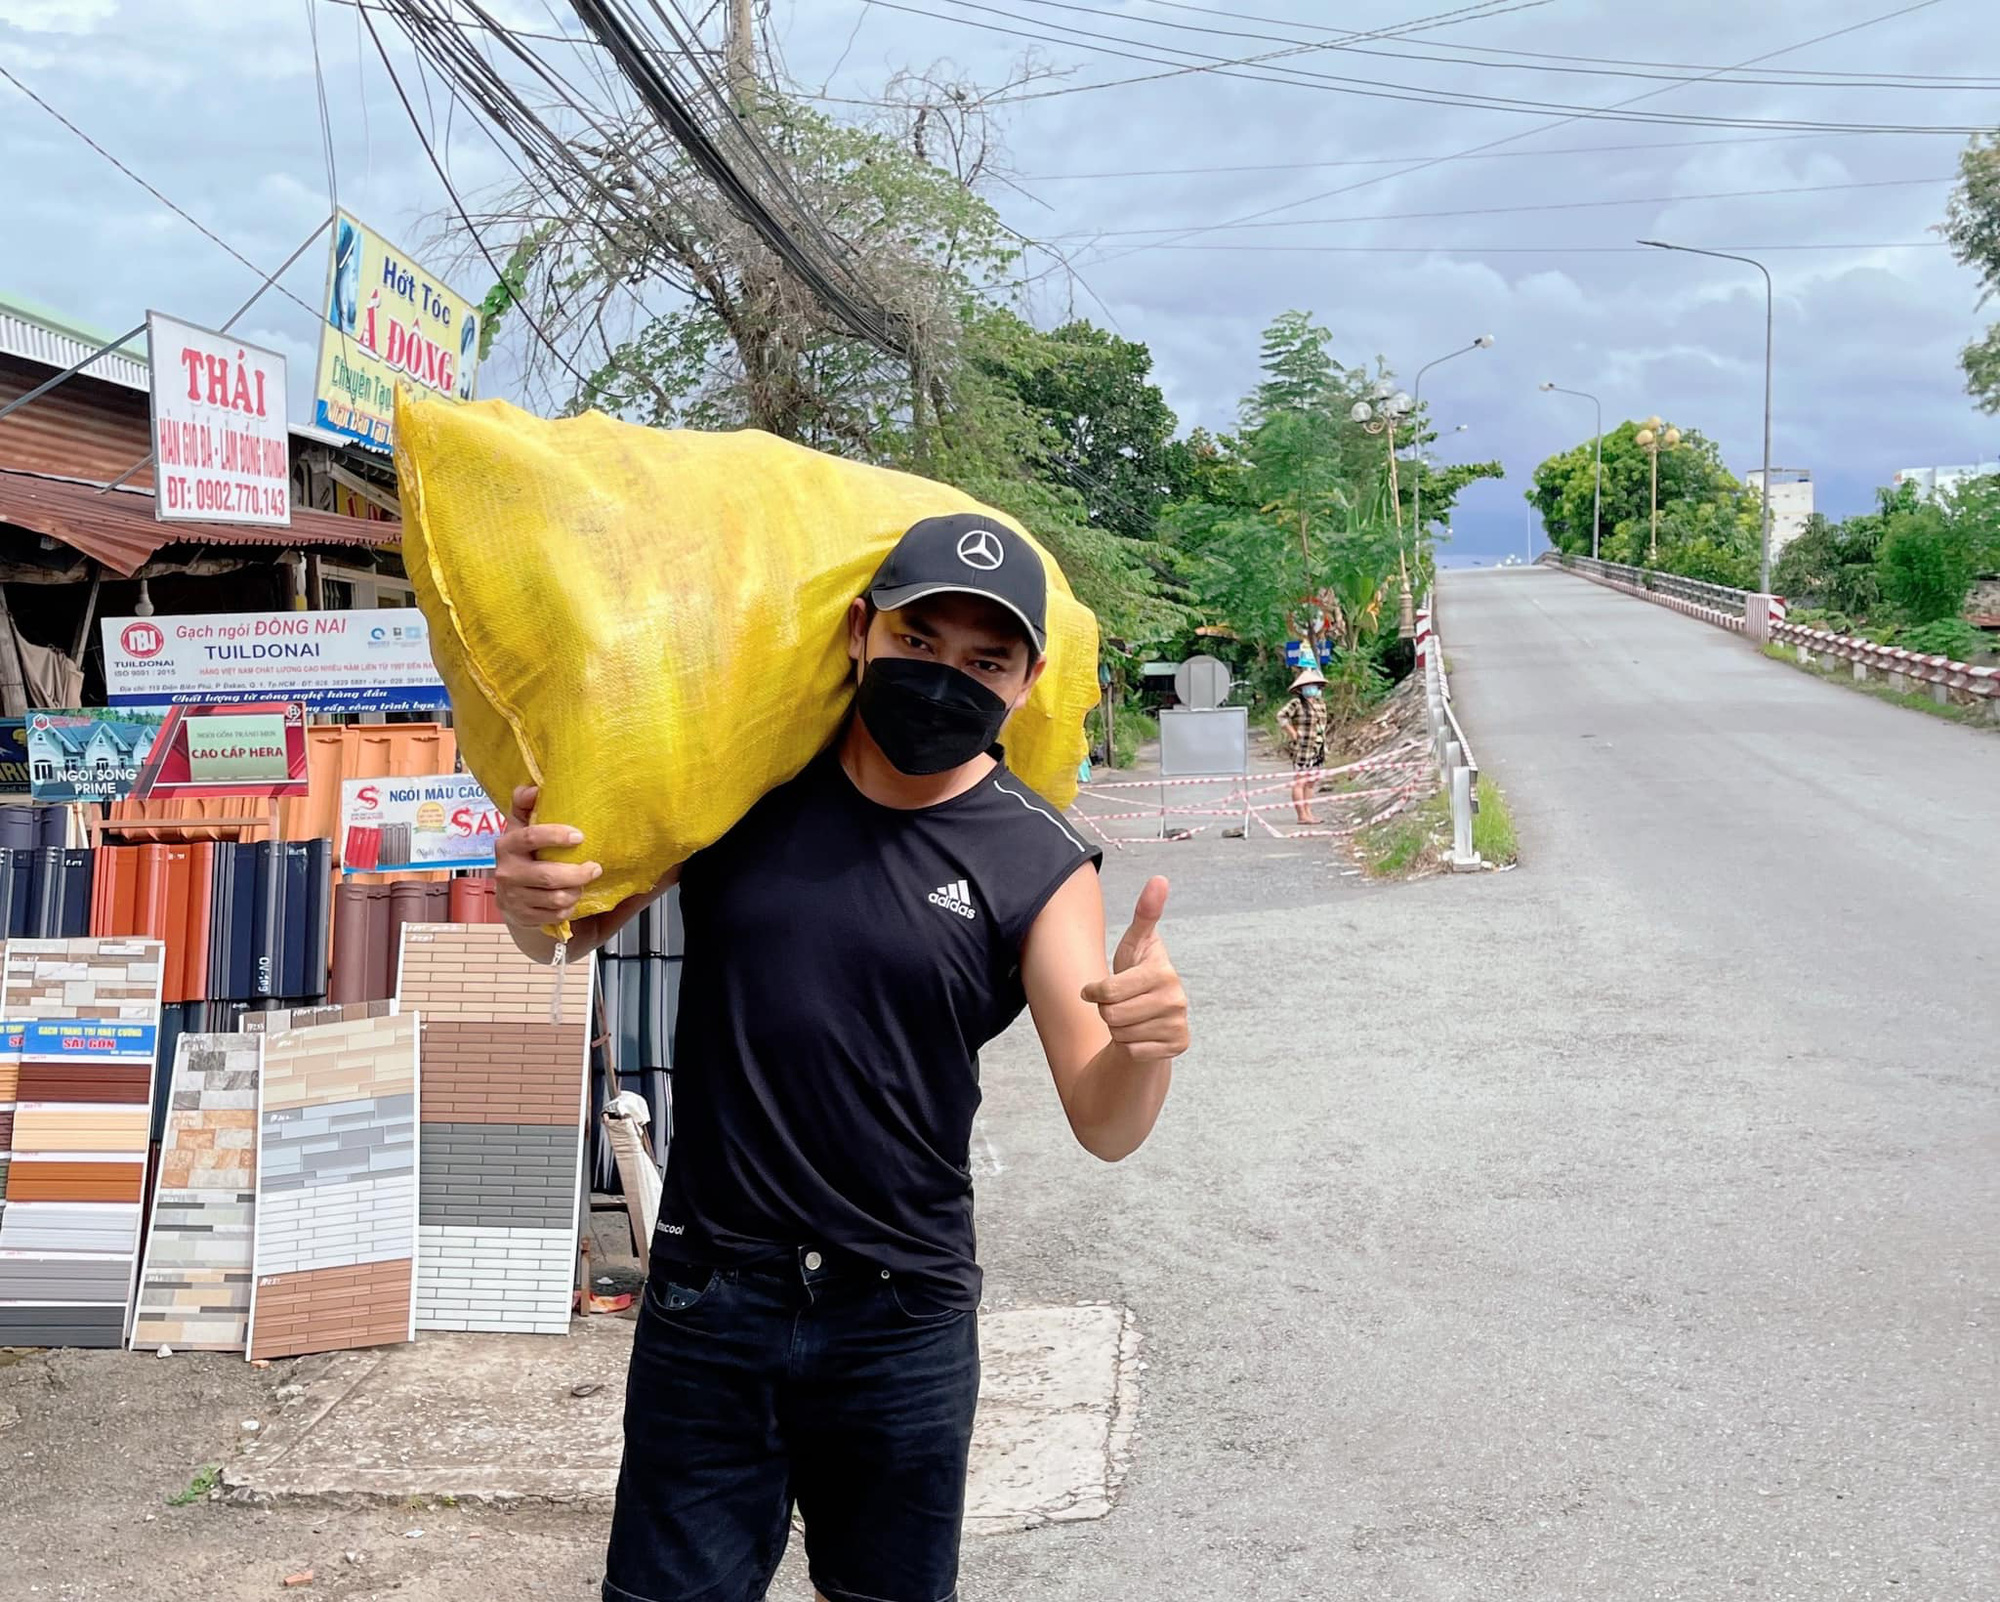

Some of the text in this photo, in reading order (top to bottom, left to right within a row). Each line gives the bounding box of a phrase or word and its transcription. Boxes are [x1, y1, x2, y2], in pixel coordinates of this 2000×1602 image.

[383, 256, 450, 325] Hớt Tóc
[358, 289, 454, 391] Á ĐÔNG
[182, 348, 267, 417] THÁI
[167, 476, 285, 517] ĐT: 0902.770.143
[176, 625, 213, 640] Gạch
[218, 623, 250, 640] ngói
[314, 618, 347, 634] NAI
[204, 643, 320, 660] TUILDONAI
[114, 660, 174, 668] TUILDONAI
[191, 748, 219, 759] CAO
[249, 746, 284, 758] HERA
[57, 768, 93, 782] NGÓI
[75, 782, 117, 795] PRIME
[389, 786, 420, 802] NGÓI
[424, 785, 454, 799] MÀU
[928, 893, 975, 919] adidas
